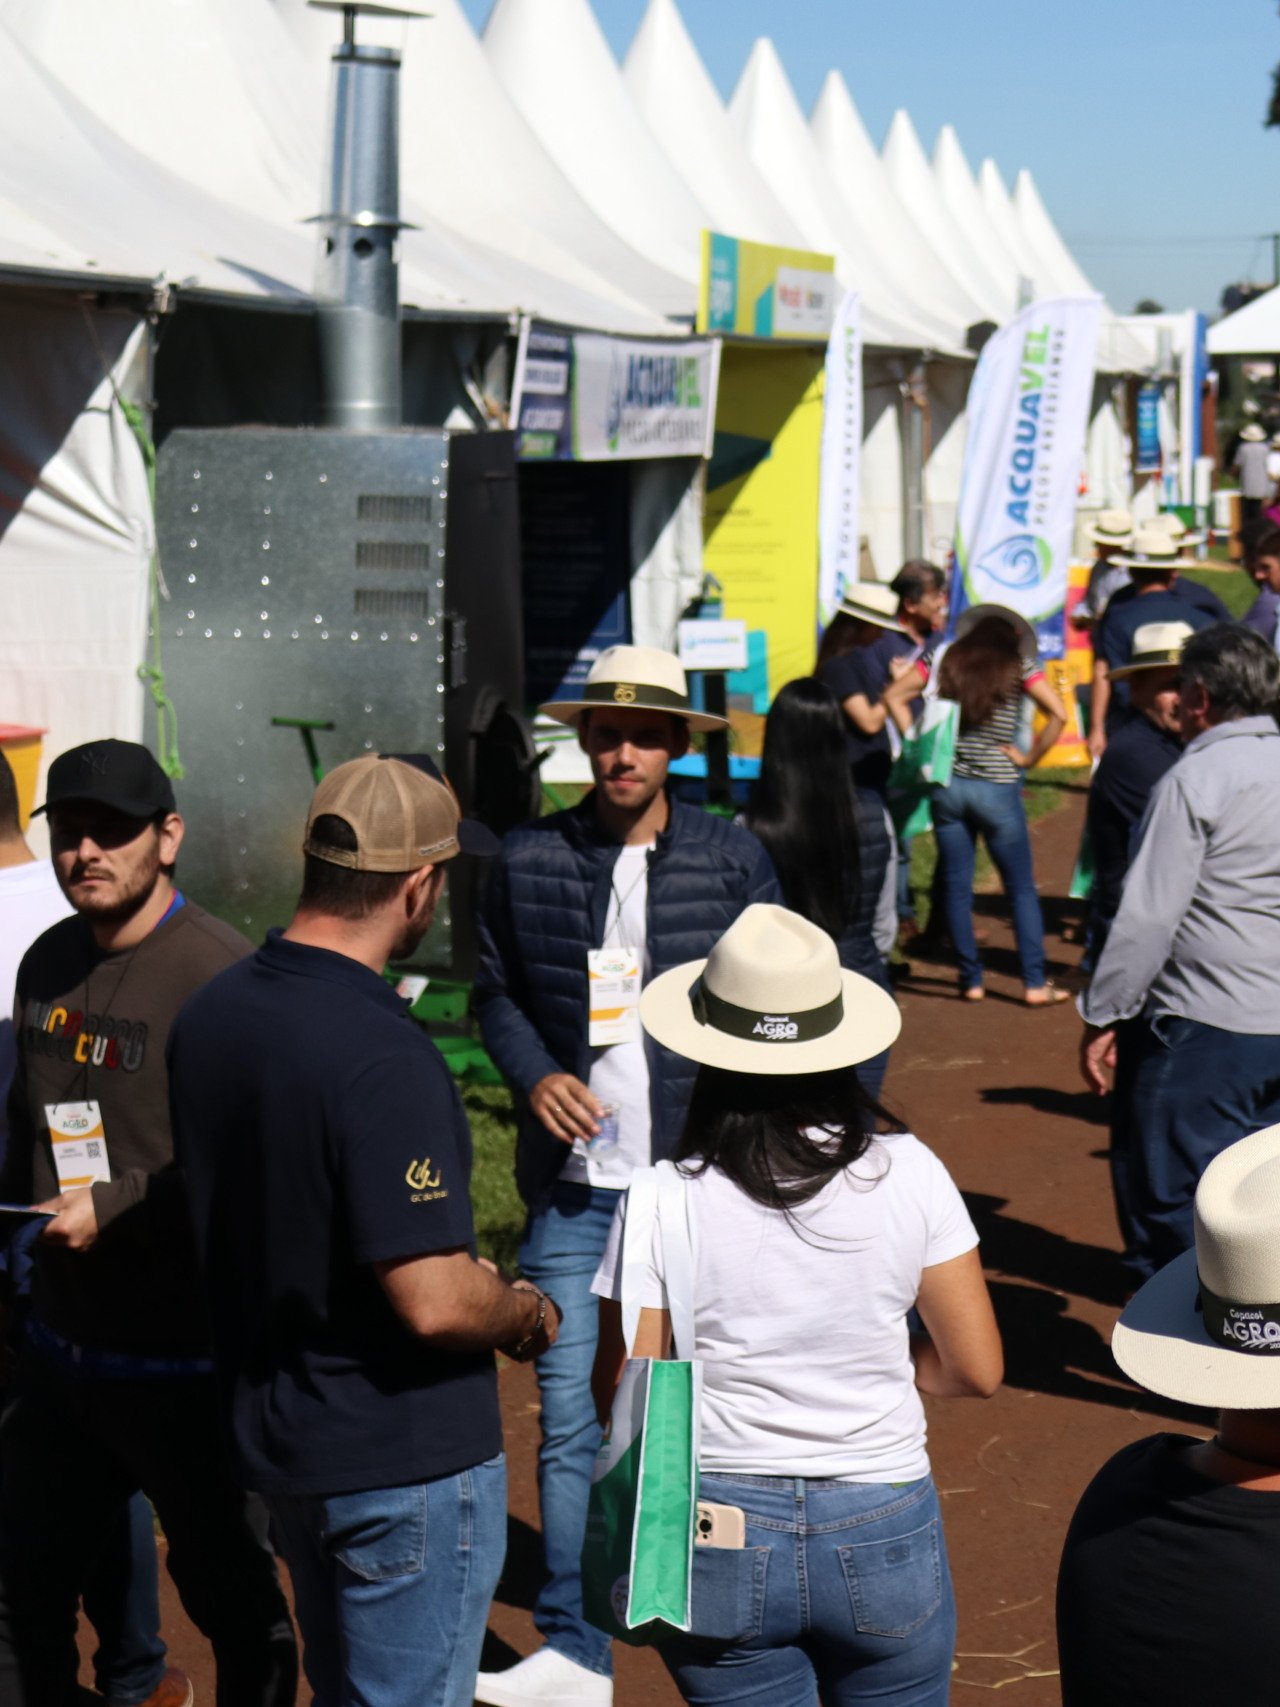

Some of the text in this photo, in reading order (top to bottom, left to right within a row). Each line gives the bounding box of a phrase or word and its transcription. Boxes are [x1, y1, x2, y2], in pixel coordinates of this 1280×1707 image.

[1006, 324, 1050, 526] ACQUAVEL
[752, 1021, 798, 1036] AGRO
[1229, 1308, 1264, 1321] Copacol
